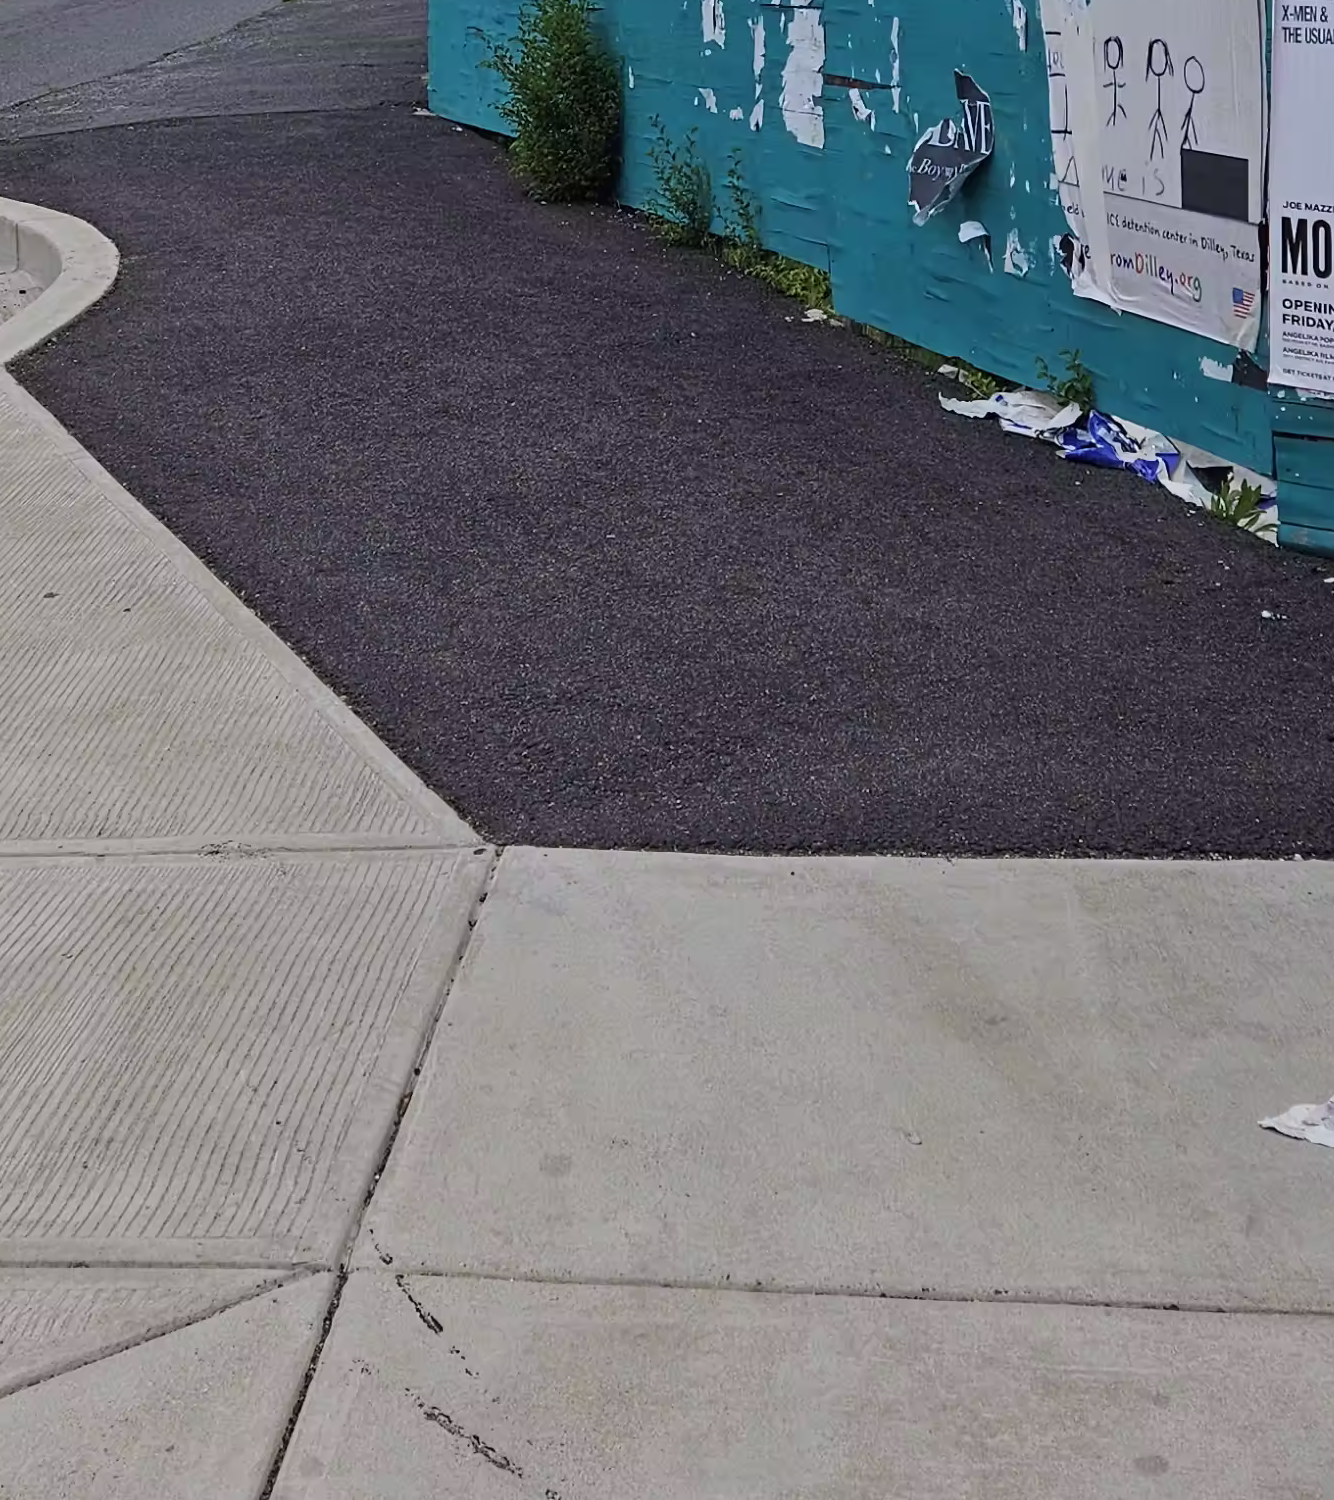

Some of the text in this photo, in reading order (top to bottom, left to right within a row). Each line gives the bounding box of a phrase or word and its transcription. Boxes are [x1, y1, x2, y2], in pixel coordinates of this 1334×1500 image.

[1281, 5, 1328, 23] X-MEN &
[1121, 216, 1161, 240] detention
[1162, 228, 1188, 245] center
[1189, 231, 1198, 247] in
[1200, 235, 1229, 261] Dilley,
[1230, 244, 1255, 263] Texas
[1109, 251, 1203, 302] romDilley.org
